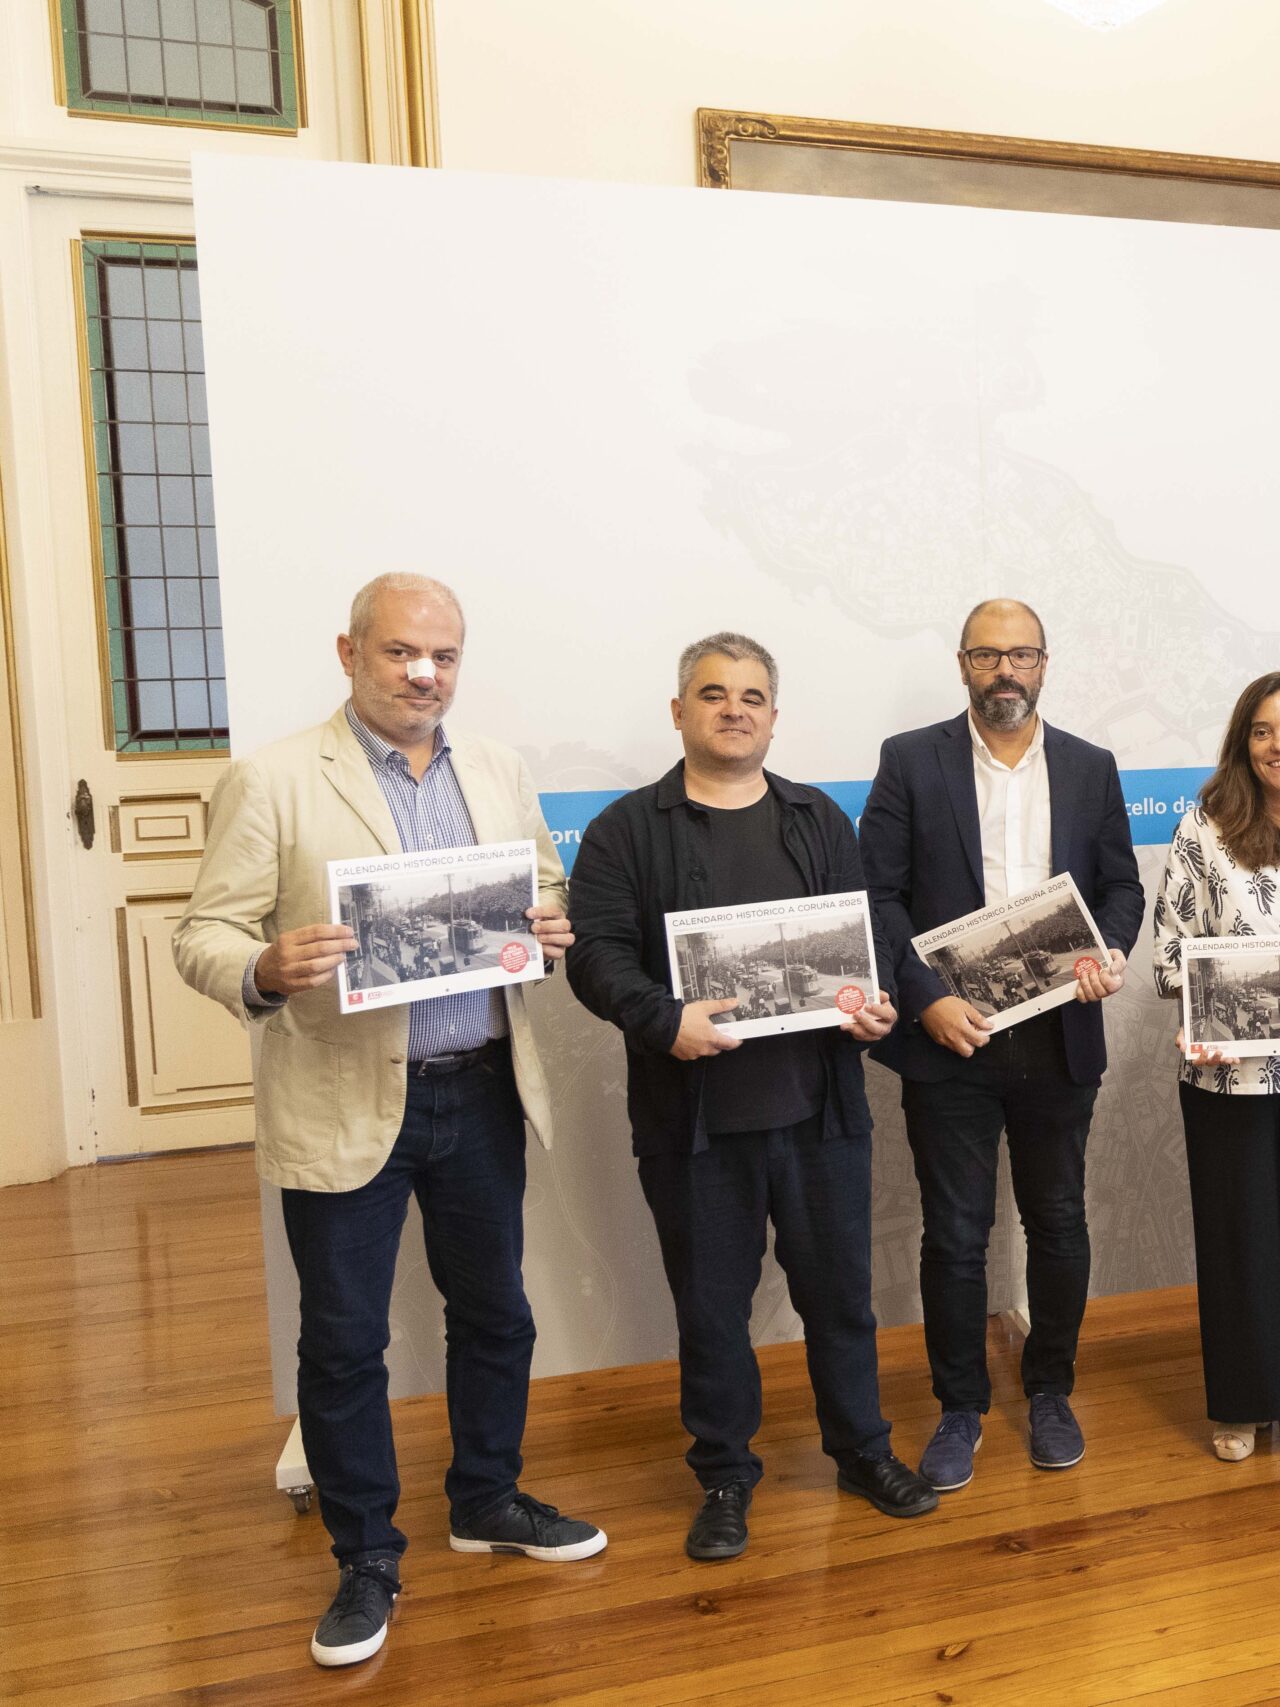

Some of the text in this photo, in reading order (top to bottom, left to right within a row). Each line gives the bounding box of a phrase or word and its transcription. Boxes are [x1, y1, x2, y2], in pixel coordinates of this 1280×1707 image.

[335, 862, 400, 878] CALENDARIO
[404, 855, 454, 869] HISTÓRICO
[457, 855, 465, 863] A
[467, 849, 506, 862] CORUÑA
[508, 847, 531, 858] 2025
[672, 913, 733, 927] CALENDARIO
[736, 906, 785, 920] HISTÓRICO
[788, 905, 795, 913] A
[797, 901, 836, 912] CORUÑA
[838, 898, 863, 908] 2025
[918, 923, 965, 949] CALENDARIO
[966, 906, 1006, 928] HISTÓRICO
[1007, 902, 1014, 910] A
[1015, 888, 1047, 908] CORUÑA
[1047, 880, 1069, 894] 2025
[1186, 942, 1239, 951] CALENDARIO
